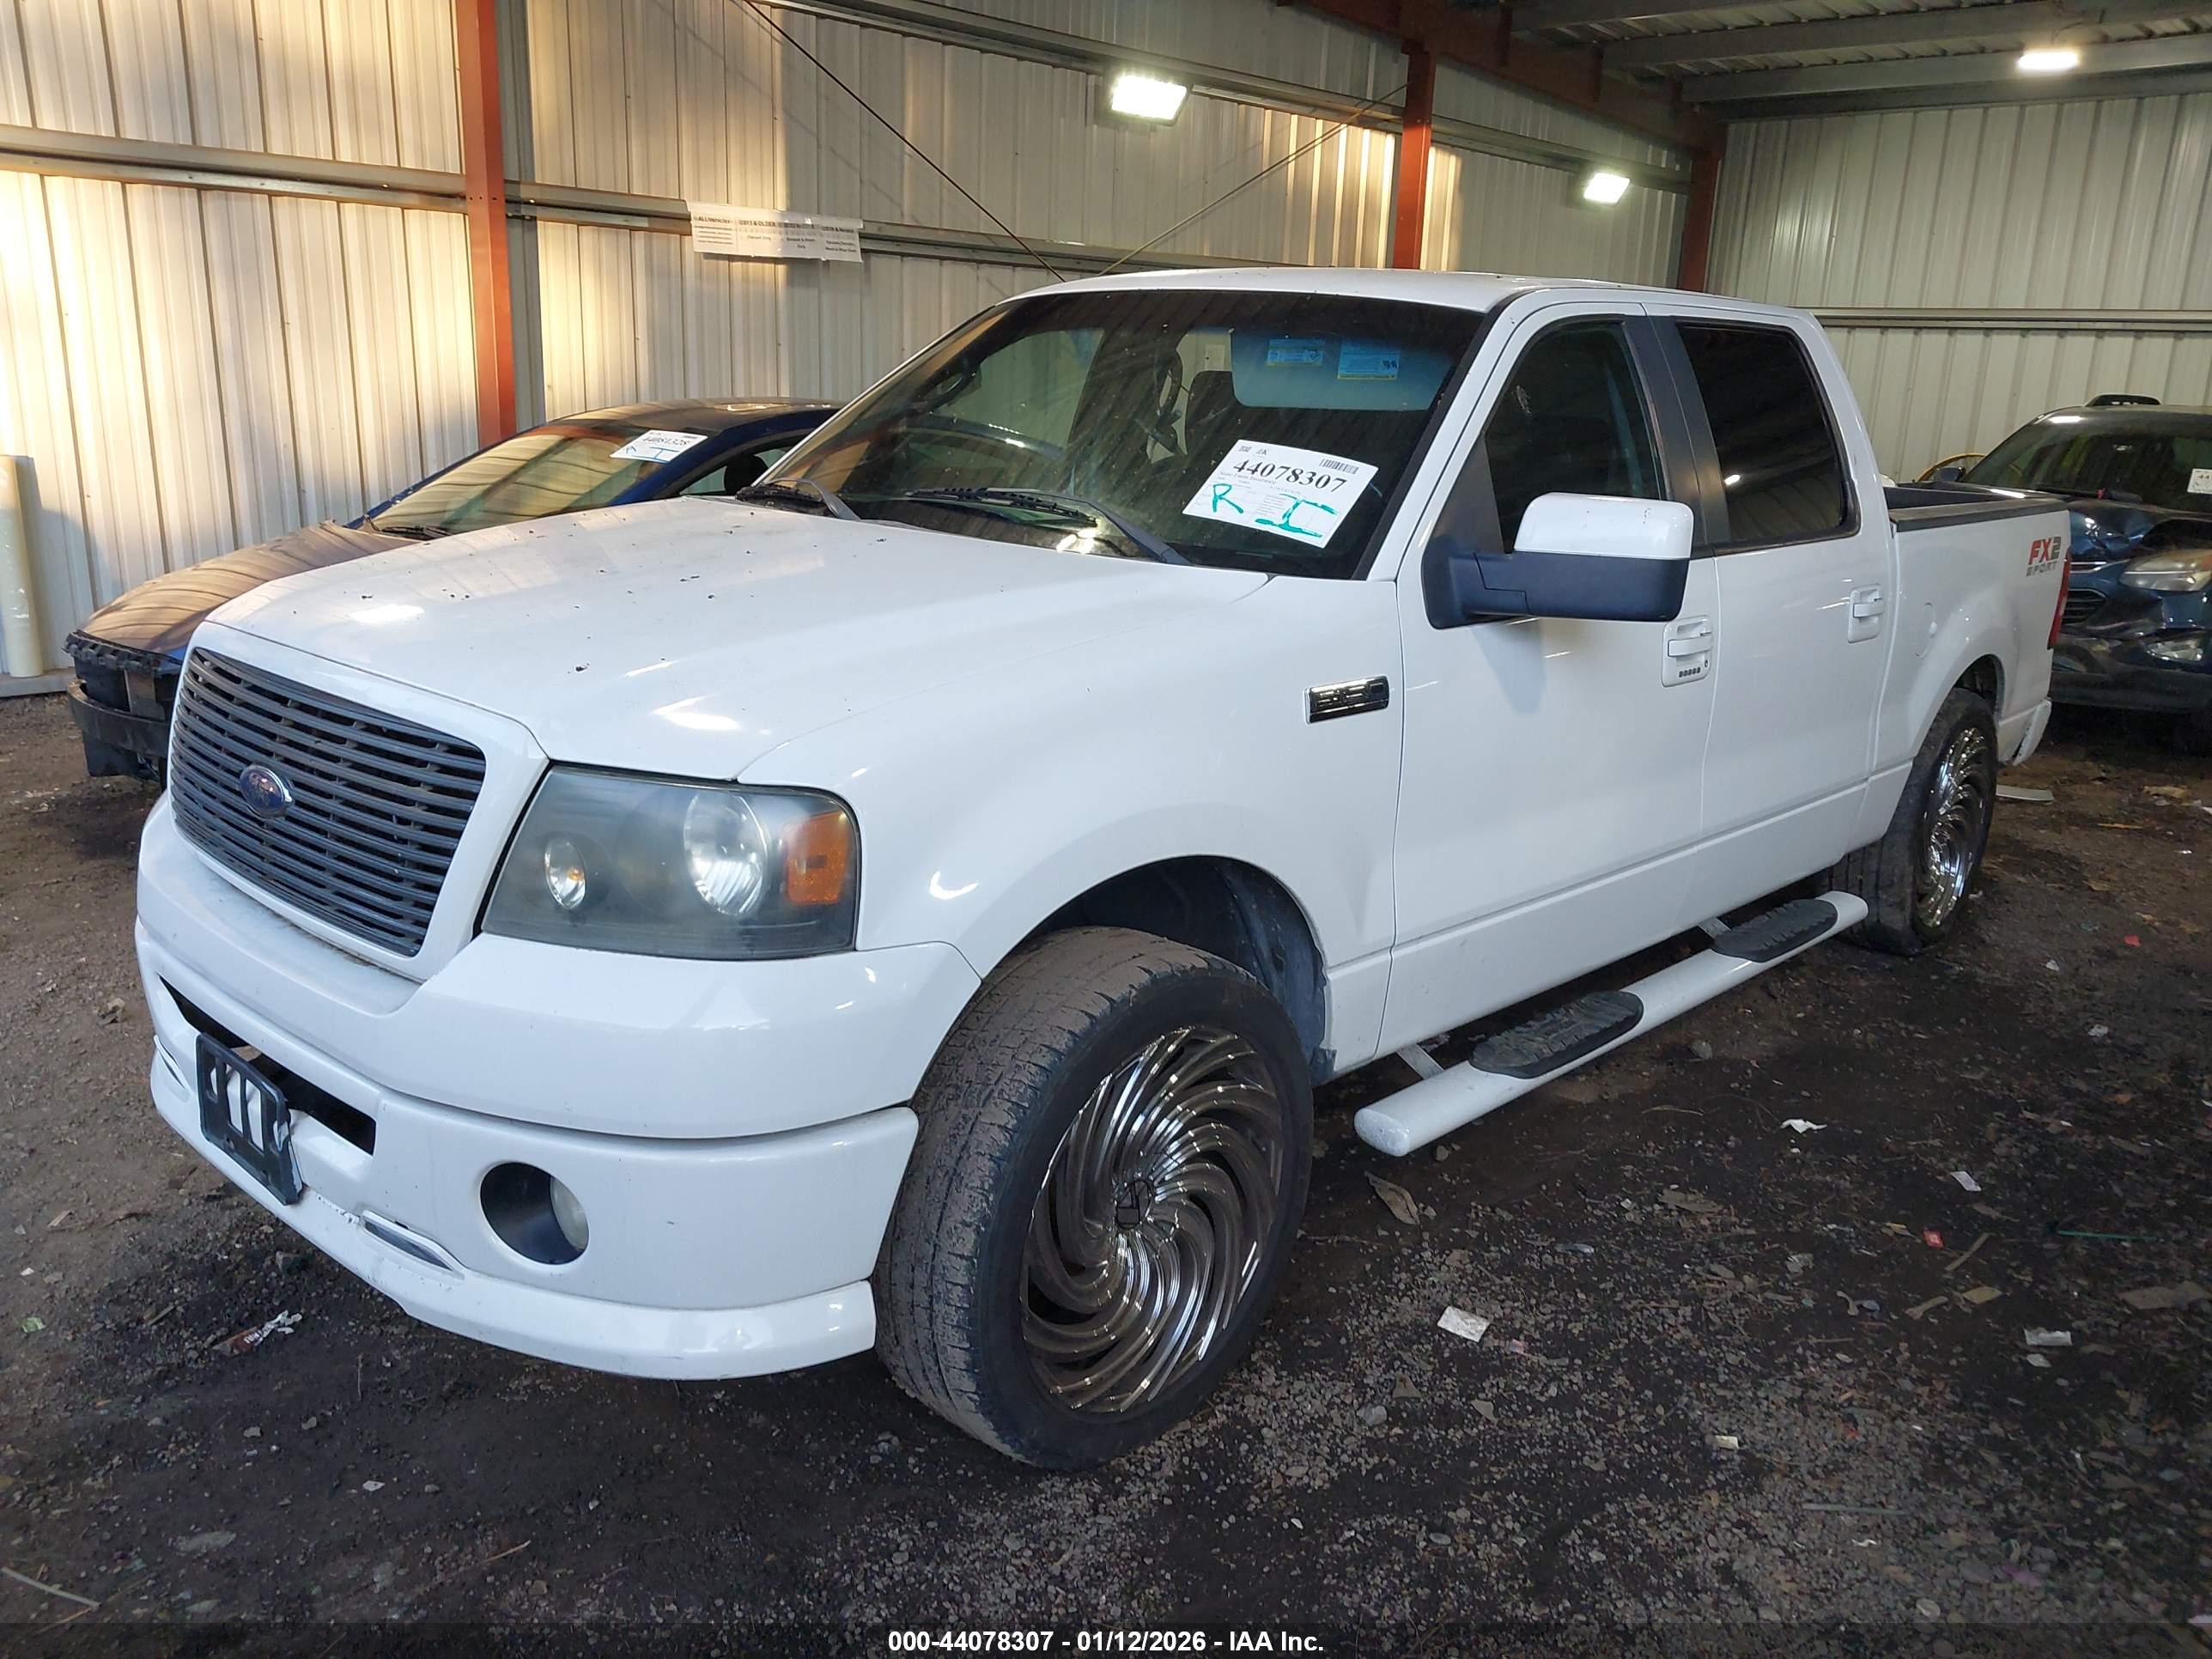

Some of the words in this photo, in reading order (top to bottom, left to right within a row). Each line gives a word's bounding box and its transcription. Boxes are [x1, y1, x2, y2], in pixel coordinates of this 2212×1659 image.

[1233, 458, 1347, 494] 44078307
[1212, 483, 1244, 514] R
[2027, 537, 2062, 565] FX2
[2026, 561, 2057, 577] SPORT
